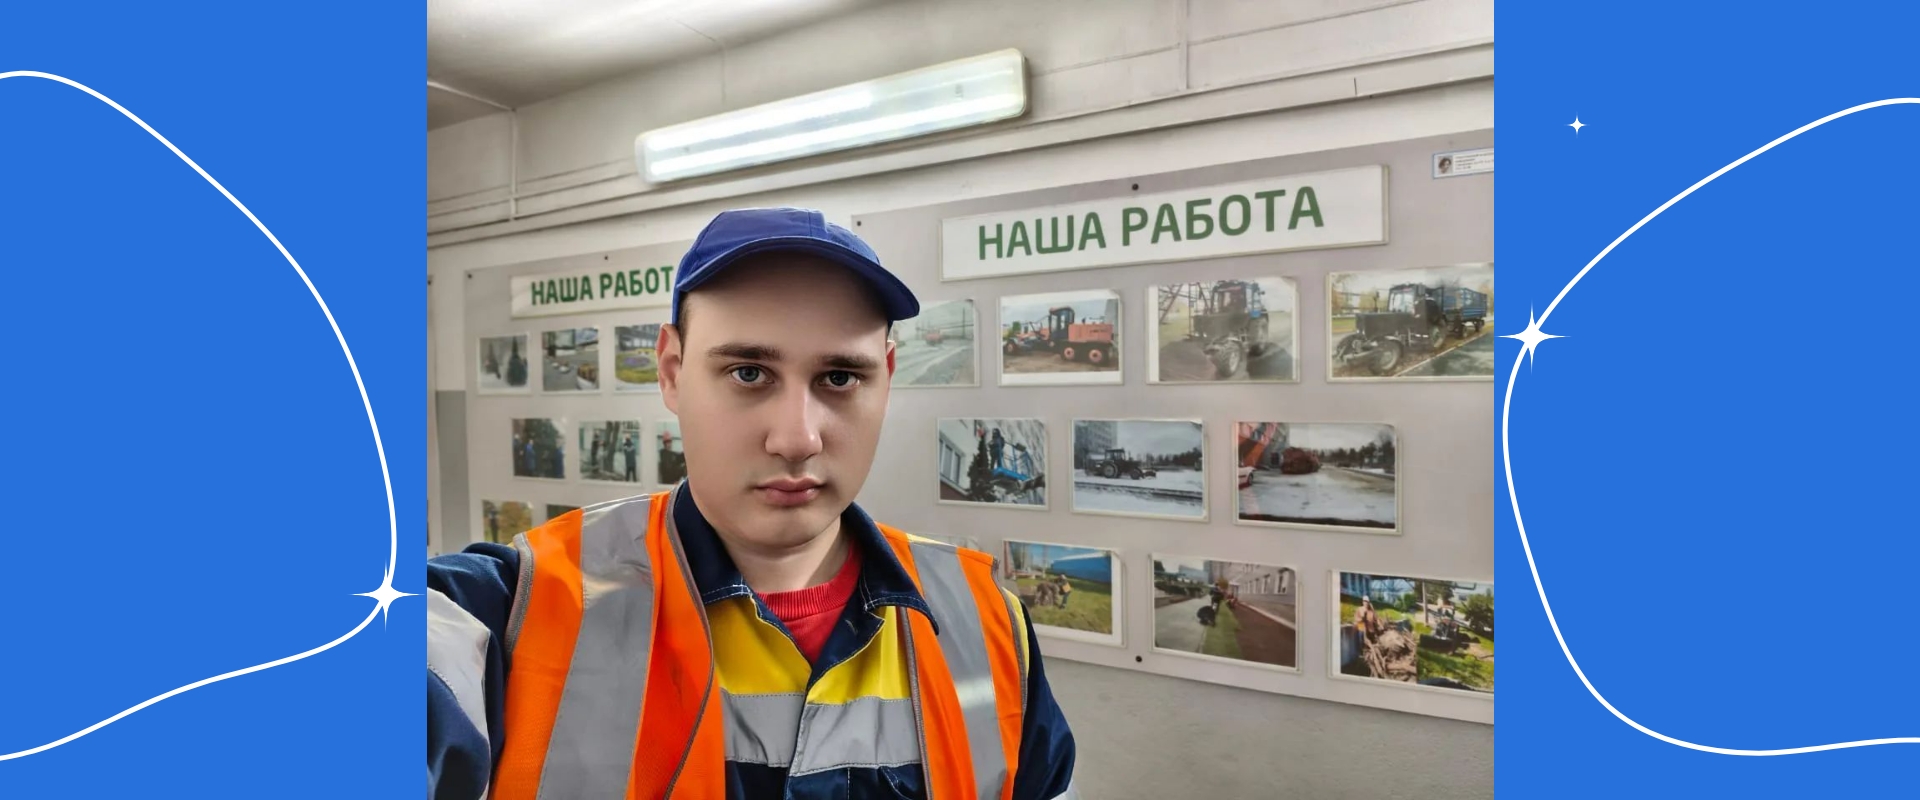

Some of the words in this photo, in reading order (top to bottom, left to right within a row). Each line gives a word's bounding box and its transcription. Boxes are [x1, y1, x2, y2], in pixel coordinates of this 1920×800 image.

[978, 211, 1106, 260] НАША
[1121, 186, 1324, 246] РАБОТА
[531, 275, 594, 306] НАША
[600, 266, 675, 299] РАБОТ
